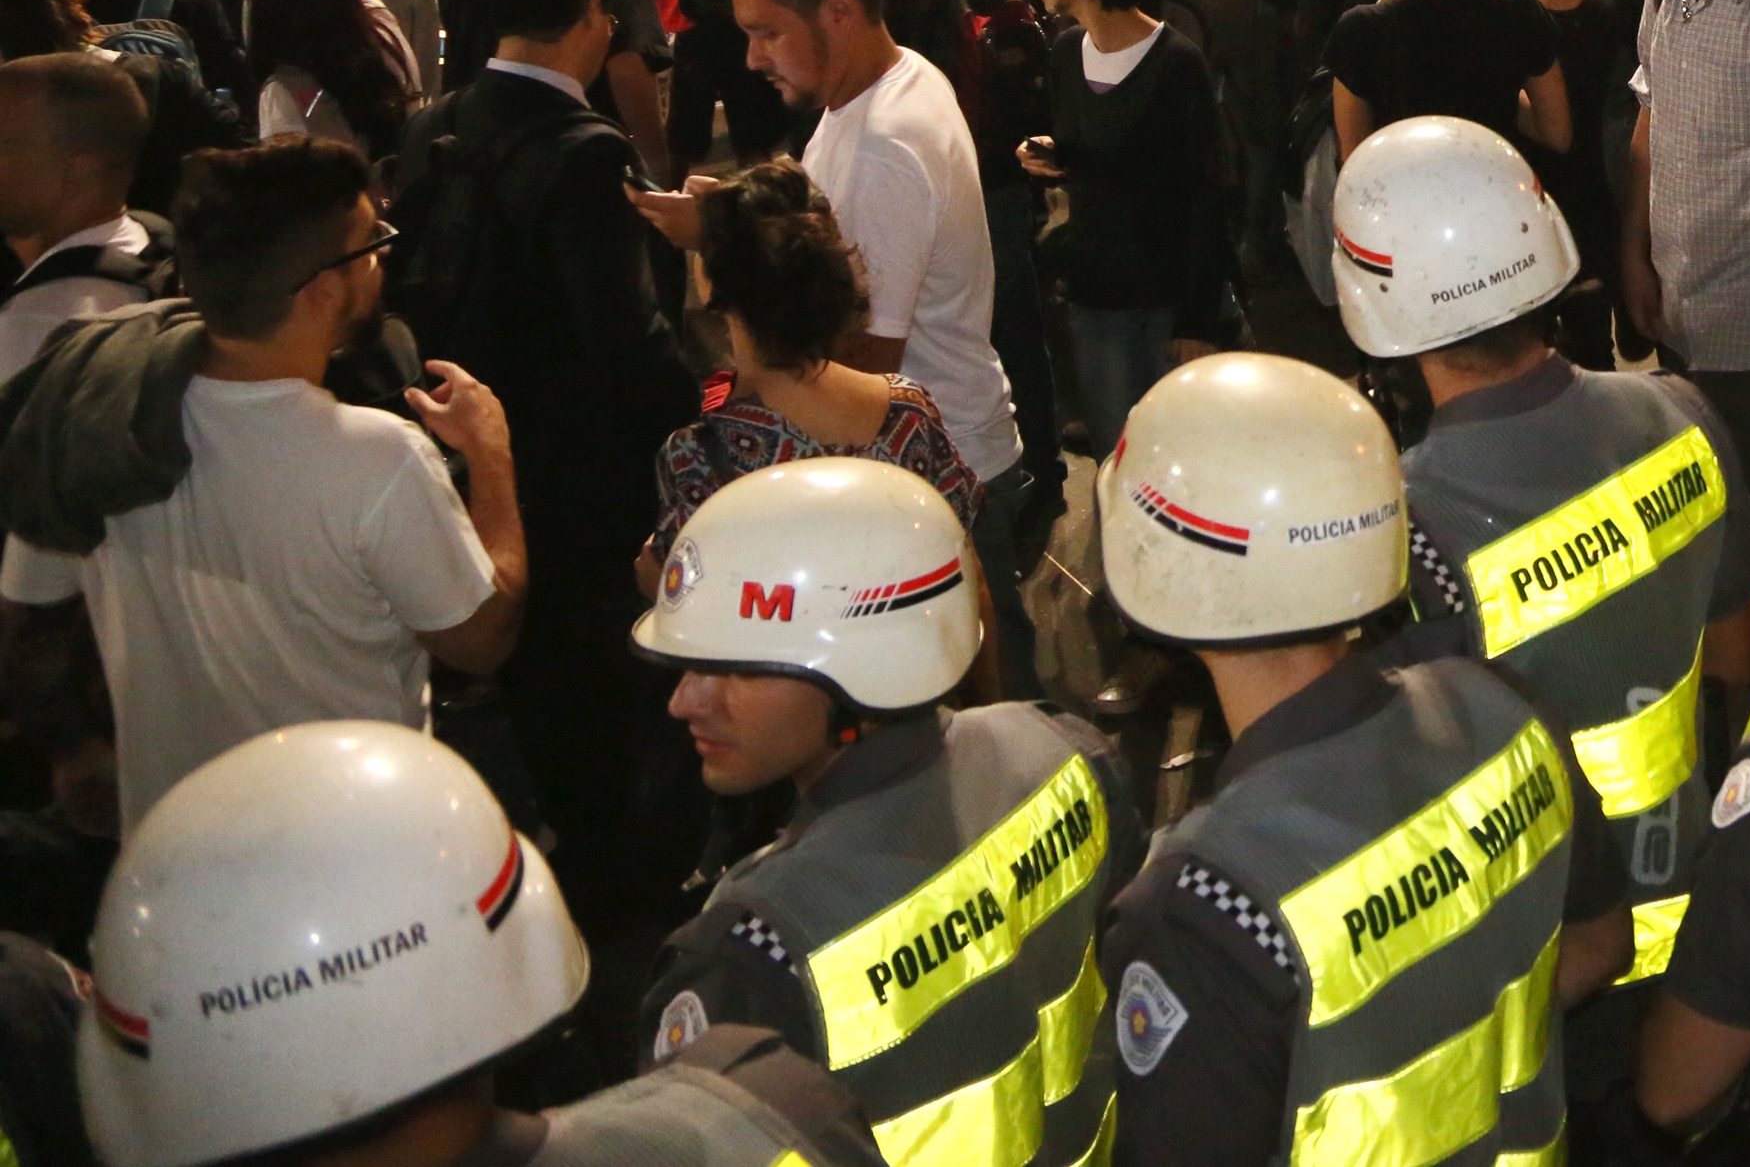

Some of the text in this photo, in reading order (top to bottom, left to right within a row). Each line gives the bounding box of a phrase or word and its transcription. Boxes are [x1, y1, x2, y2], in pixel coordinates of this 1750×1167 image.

[1489, 252, 1537, 286] MILITAR
[1509, 461, 1708, 603] POLICIA MILITAR
[739, 581, 796, 622] M
[866, 798, 1093, 1006] POLICIA MILITAR
[1343, 763, 1556, 957] POLICIA MILITAR
[200, 921, 429, 1019] POLÍCIA MILITAR
